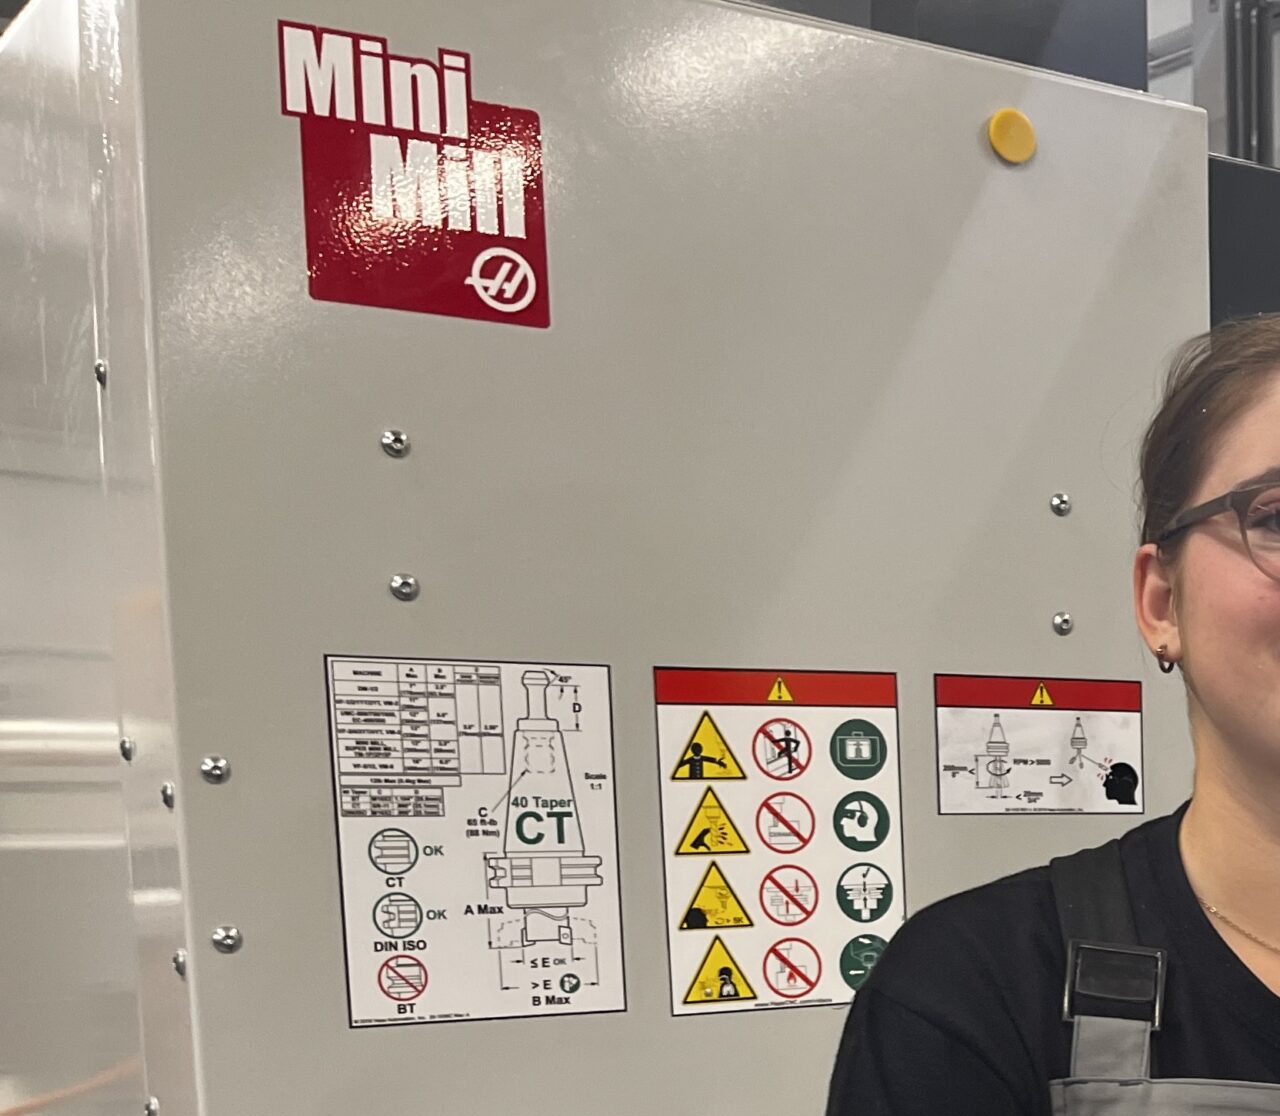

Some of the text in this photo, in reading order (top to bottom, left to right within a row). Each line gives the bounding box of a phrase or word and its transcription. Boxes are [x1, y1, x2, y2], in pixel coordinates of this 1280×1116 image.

[282, 26, 470, 139] Mini
[369, 133, 528, 240] Mill
[572, 703, 582, 713] D
[585, 772, 607, 780] Scale
[511, 796, 573, 810] 40 Taper
[478, 807, 488, 818] C
[515, 811, 573, 845] CT
[422, 845, 444, 857] OK
[385, 877, 405, 888] CT
[426, 909, 447, 921] OK
[463, 904, 504, 915] A Max
[374, 939, 427, 952] DIN ISO
[541, 957, 551, 968] E
[553, 958, 567, 966] OK
[543, 979, 552, 990] E
[532, 995, 571, 1006] B Max
[397, 1003, 416, 1014] BT
